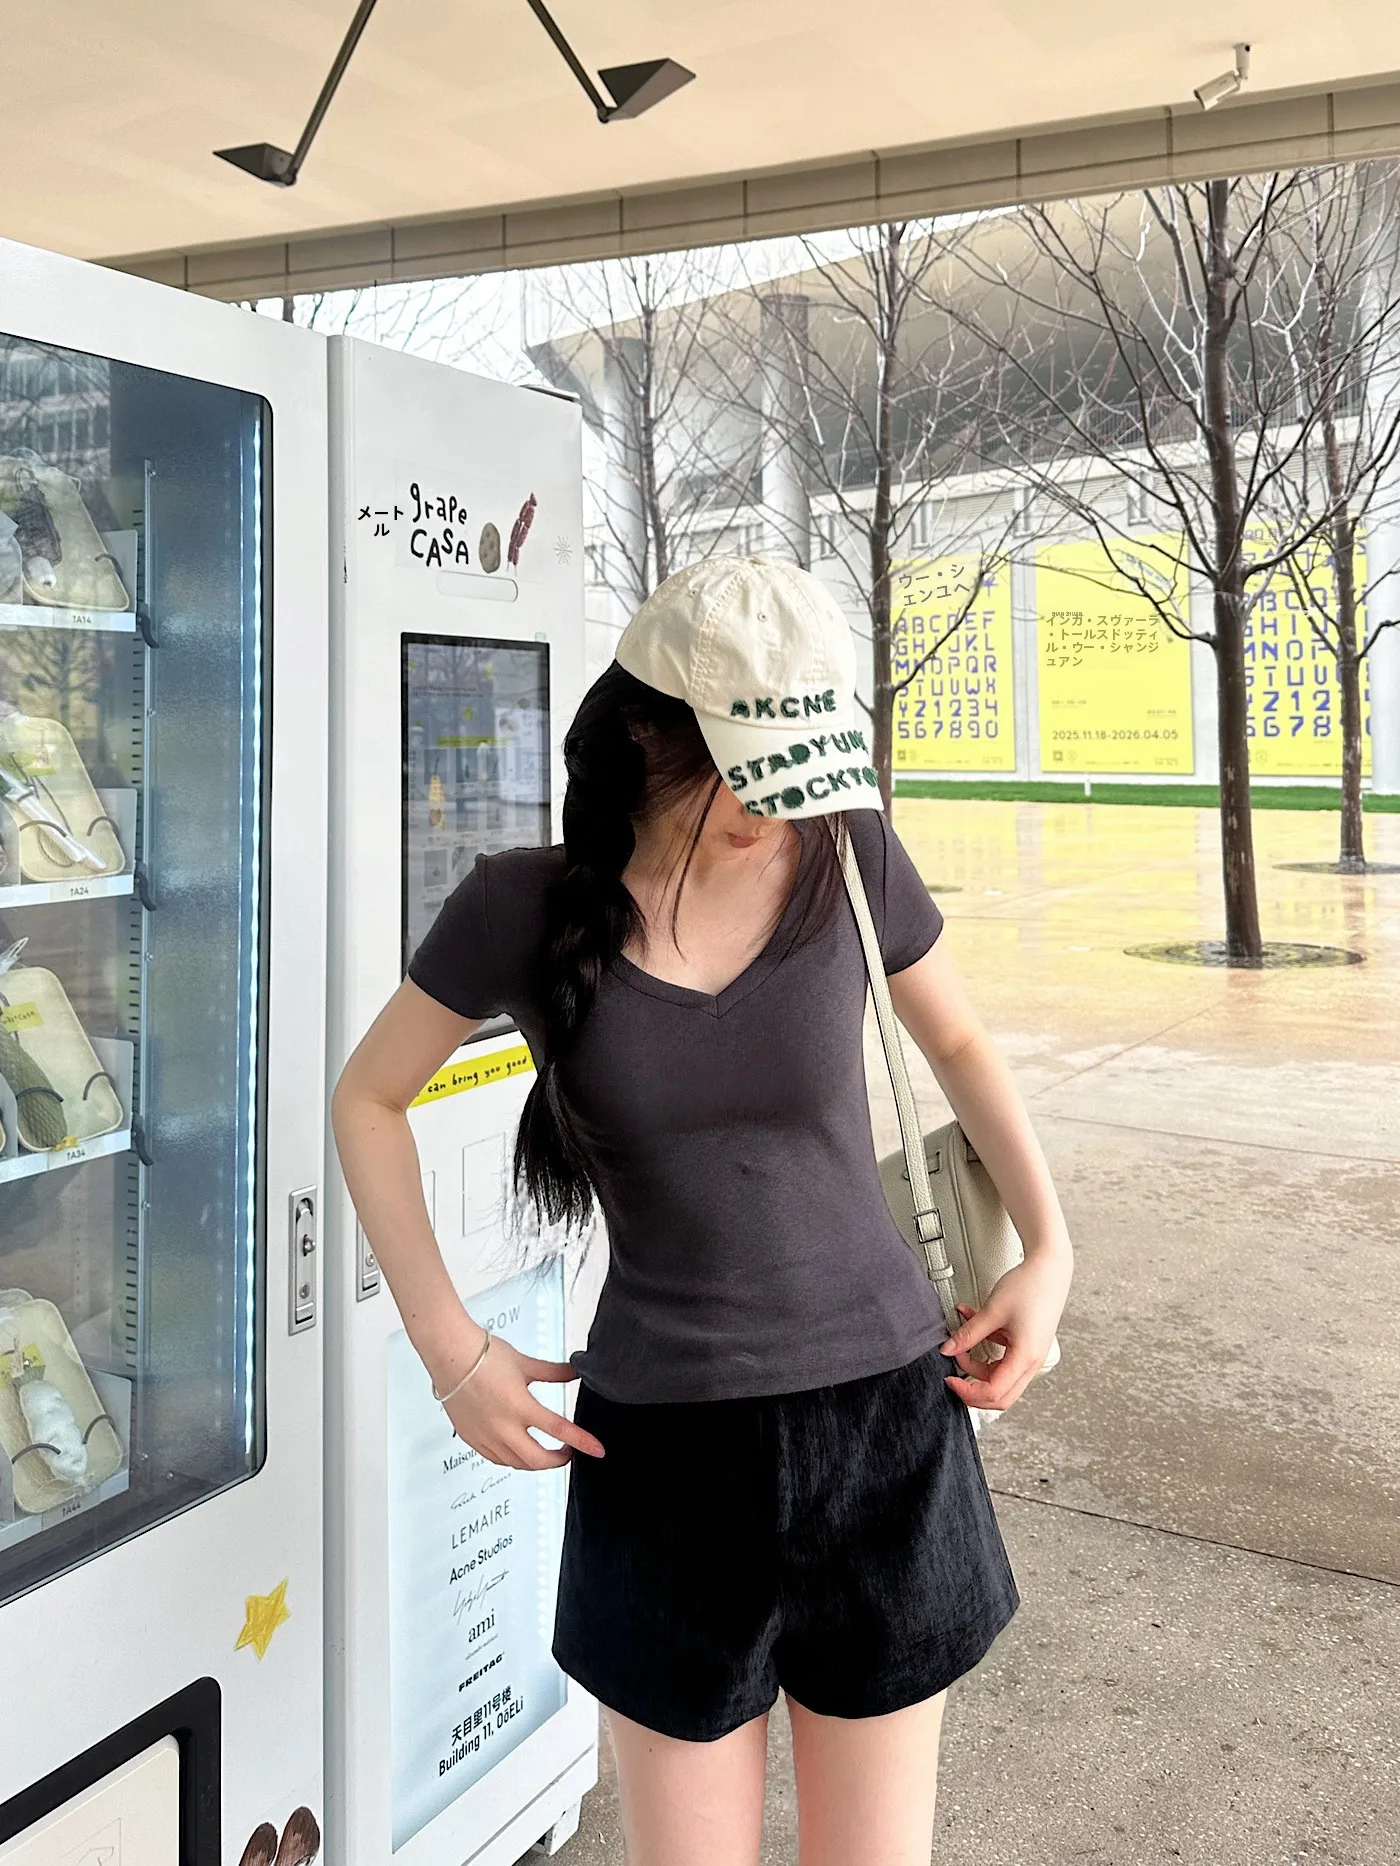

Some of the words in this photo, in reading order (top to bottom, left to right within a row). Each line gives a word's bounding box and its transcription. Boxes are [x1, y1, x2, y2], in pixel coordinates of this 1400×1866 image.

[410, 483, 467, 525] grape
[410, 528, 470, 568] CASA
[730, 689, 837, 719] AKCNE
[427, 1082, 447, 1093] can
[451, 1073, 479, 1086] bring
[484, 1066, 501, 1079] you
[506, 1056, 528, 1076] good
[451, 1498, 512, 1550] LEMAIRE
[449, 1557, 477, 1585] Acne
[477, 1534, 514, 1565] Studios
[468, 1608, 495, 1643] ami
[458, 1653, 504, 1693] FREITAG
[439, 1735, 480, 1777] Building
